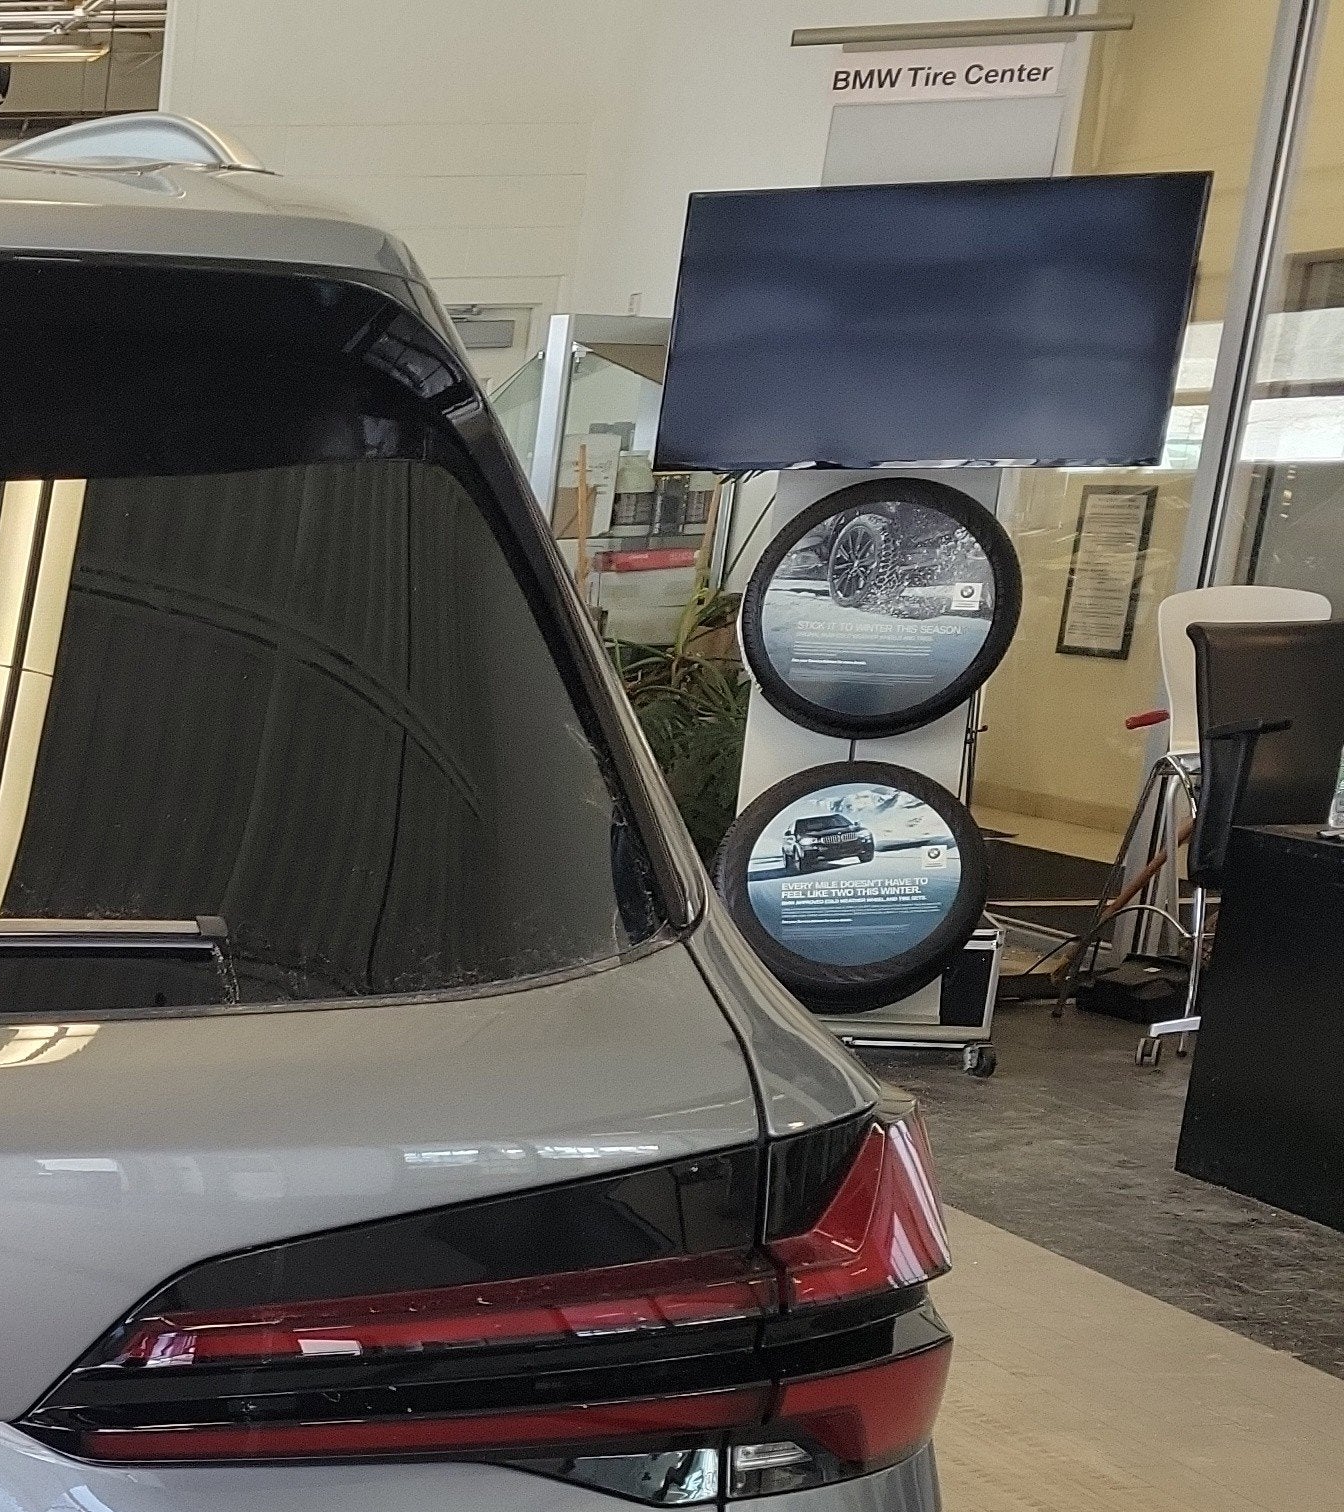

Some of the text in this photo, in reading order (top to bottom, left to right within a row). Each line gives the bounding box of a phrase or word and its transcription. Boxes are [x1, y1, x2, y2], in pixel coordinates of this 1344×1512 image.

[832, 63, 1054, 90] BMW Tire Center
[840, 622, 853, 631] TO
[856, 623, 892, 633] WINTER
[896, 625, 918, 633] THIS
[782, 877, 928, 890] EVERY MILE DOESN'T HAVE TO
[781, 890, 806, 898] FEEL
[807, 889, 829, 898] LIKE
[830, 888, 853, 897] TWO
[856, 887, 879, 896] THIS
